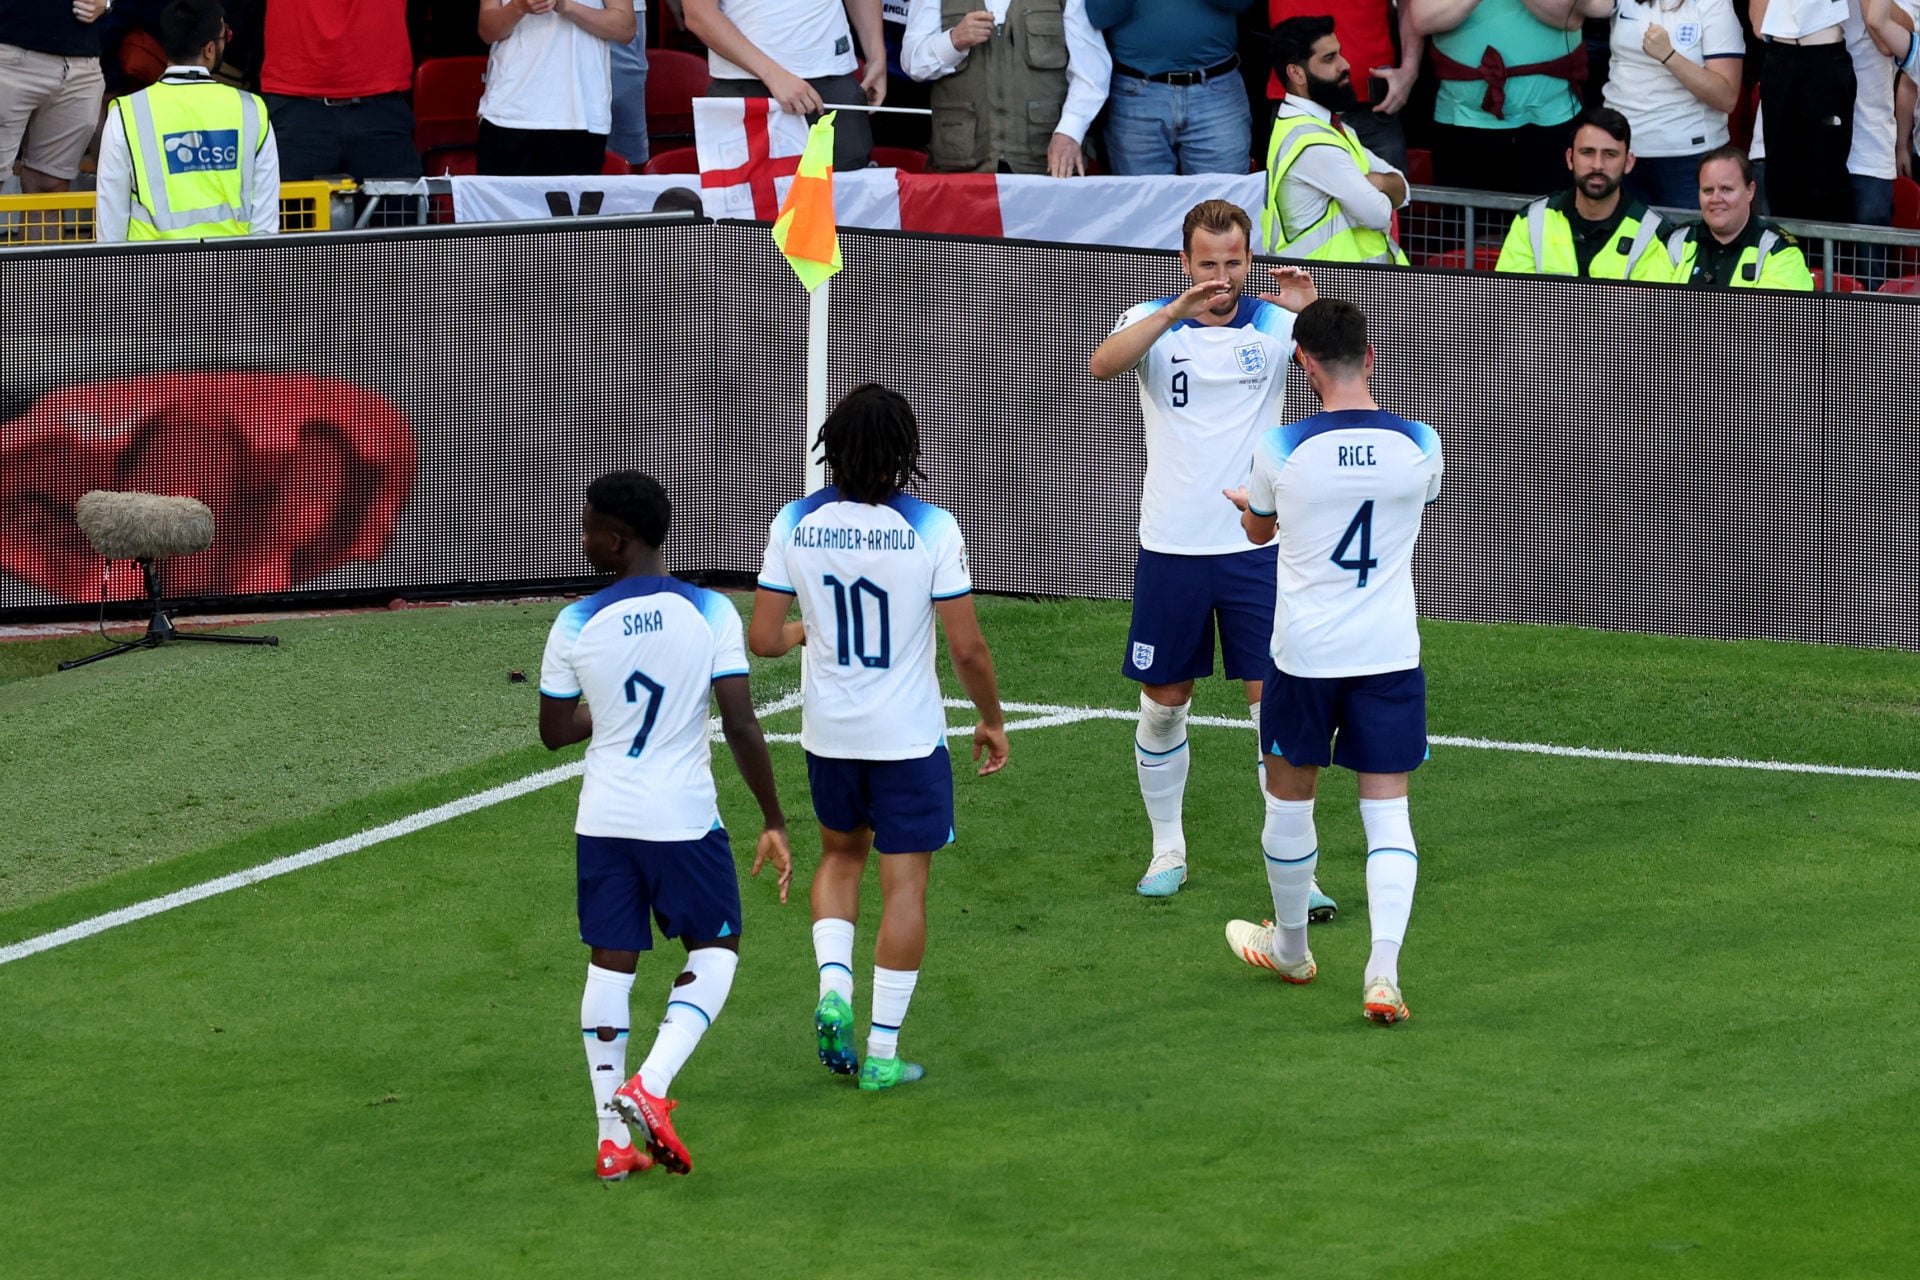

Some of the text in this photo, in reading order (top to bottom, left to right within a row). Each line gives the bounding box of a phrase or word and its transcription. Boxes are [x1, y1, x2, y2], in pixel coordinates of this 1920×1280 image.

[198, 146, 236, 163] CSG
[1172, 370, 1188, 408] 9
[794, 526, 916, 551] ALEXANDER-ARNOLD
[1330, 499, 1377, 588] 4
[623, 609, 663, 636] SAKA
[823, 574, 890, 669] 10
[624, 669, 665, 758] 7
